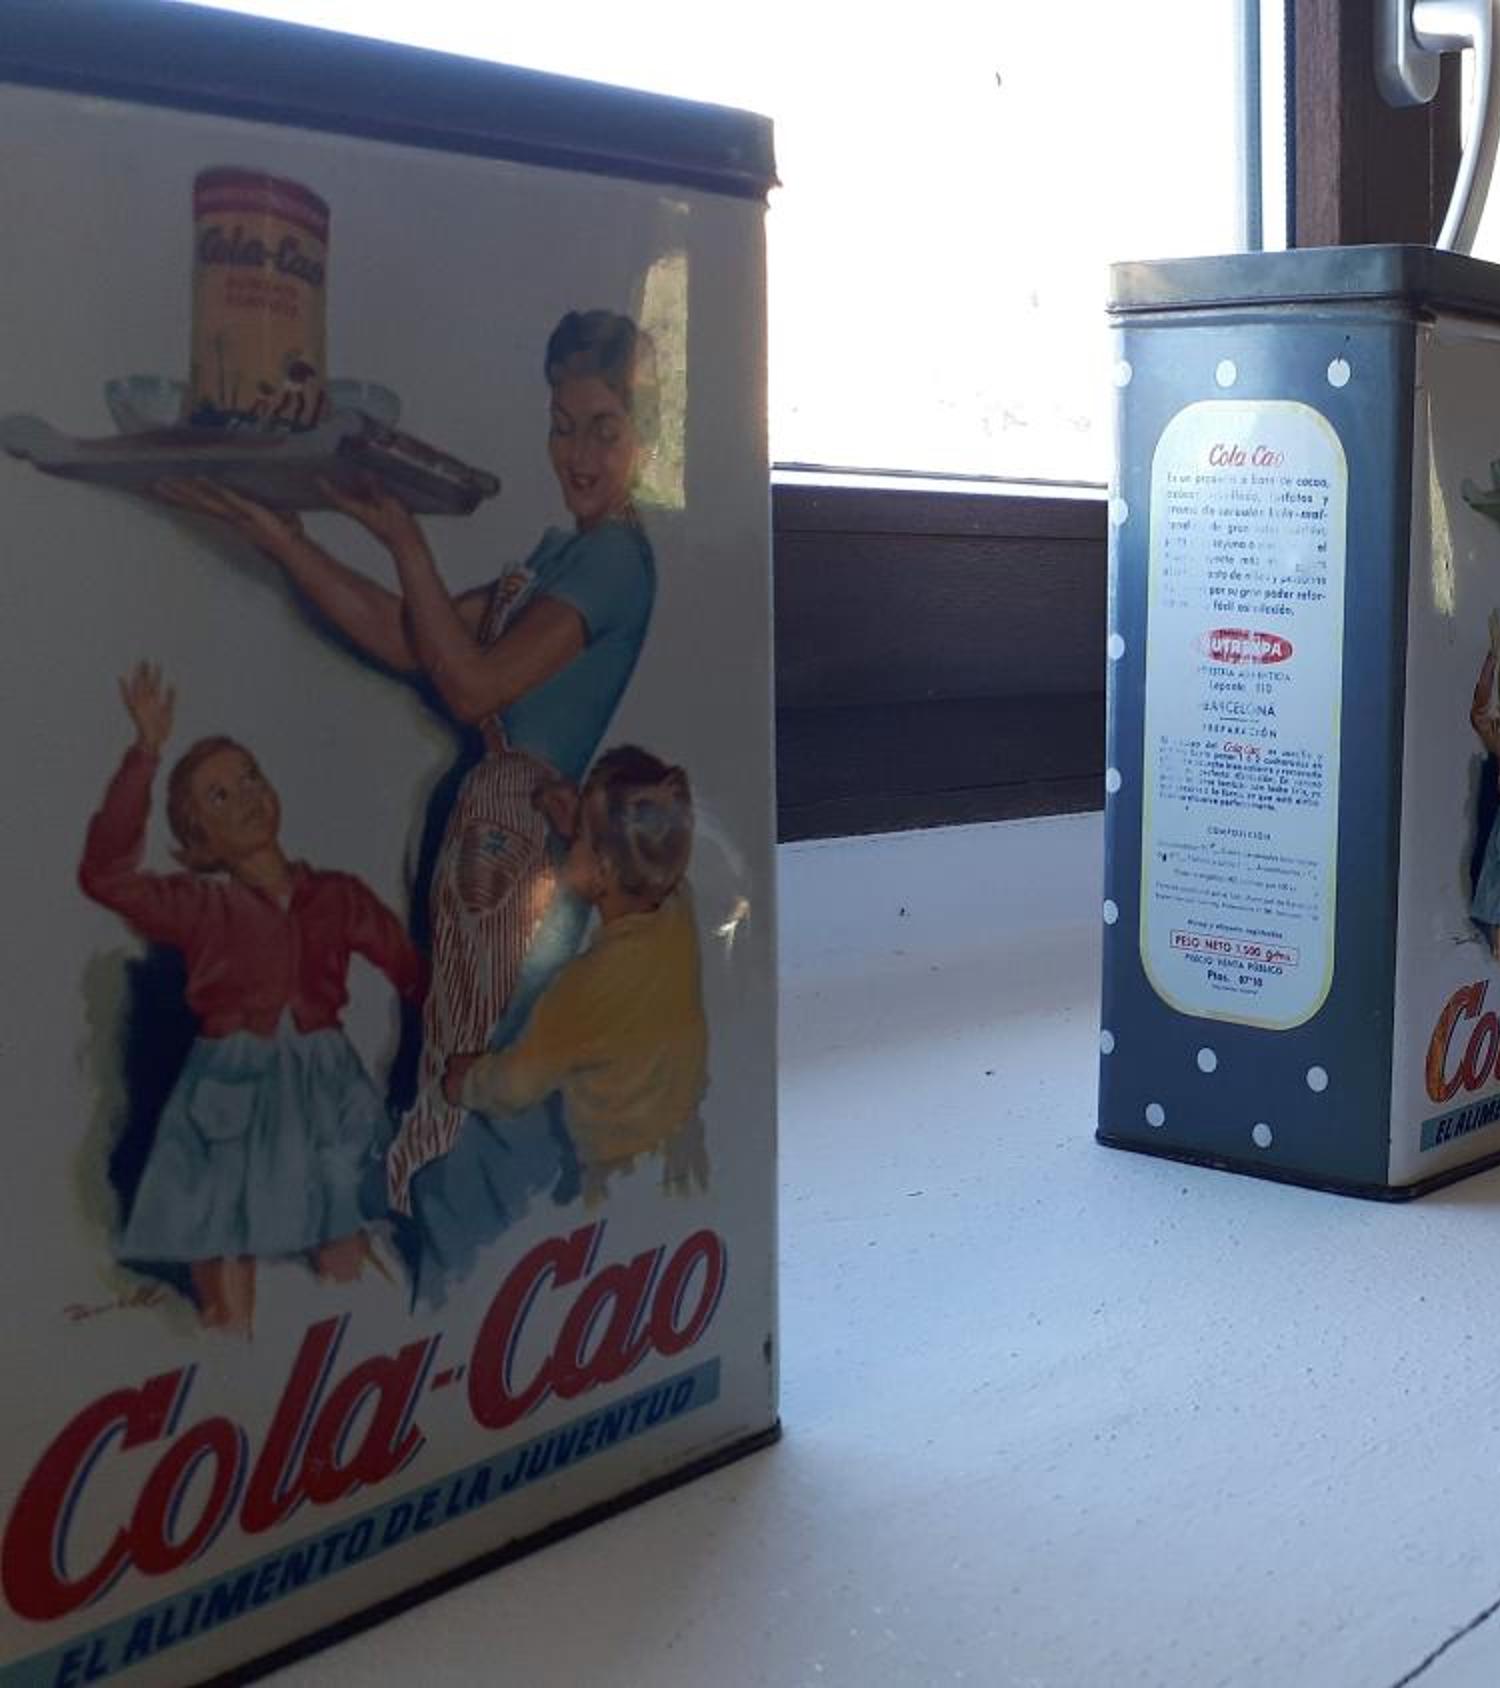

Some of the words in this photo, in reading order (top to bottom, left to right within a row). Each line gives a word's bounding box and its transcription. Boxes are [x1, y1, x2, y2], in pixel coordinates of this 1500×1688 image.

[1208, 444, 1246, 467] Cola
[1250, 445, 1286, 468] Cao
[1175, 935, 1201, 948] PESO
[1205, 939, 1232, 953] NETO
[1218, 958, 1245, 969] VENTA
[1247, 962, 1284, 976] PÚBLICO
[1, 1220, 727, 1623] Cola-Cao
[53, 1638, 111, 1688] EL
[123, 1518, 376, 1664] ALIMENTO
[382, 1486, 441, 1547] DE
[444, 1467, 493, 1518] LA
[502, 1375, 698, 1491] JUVENTUD
